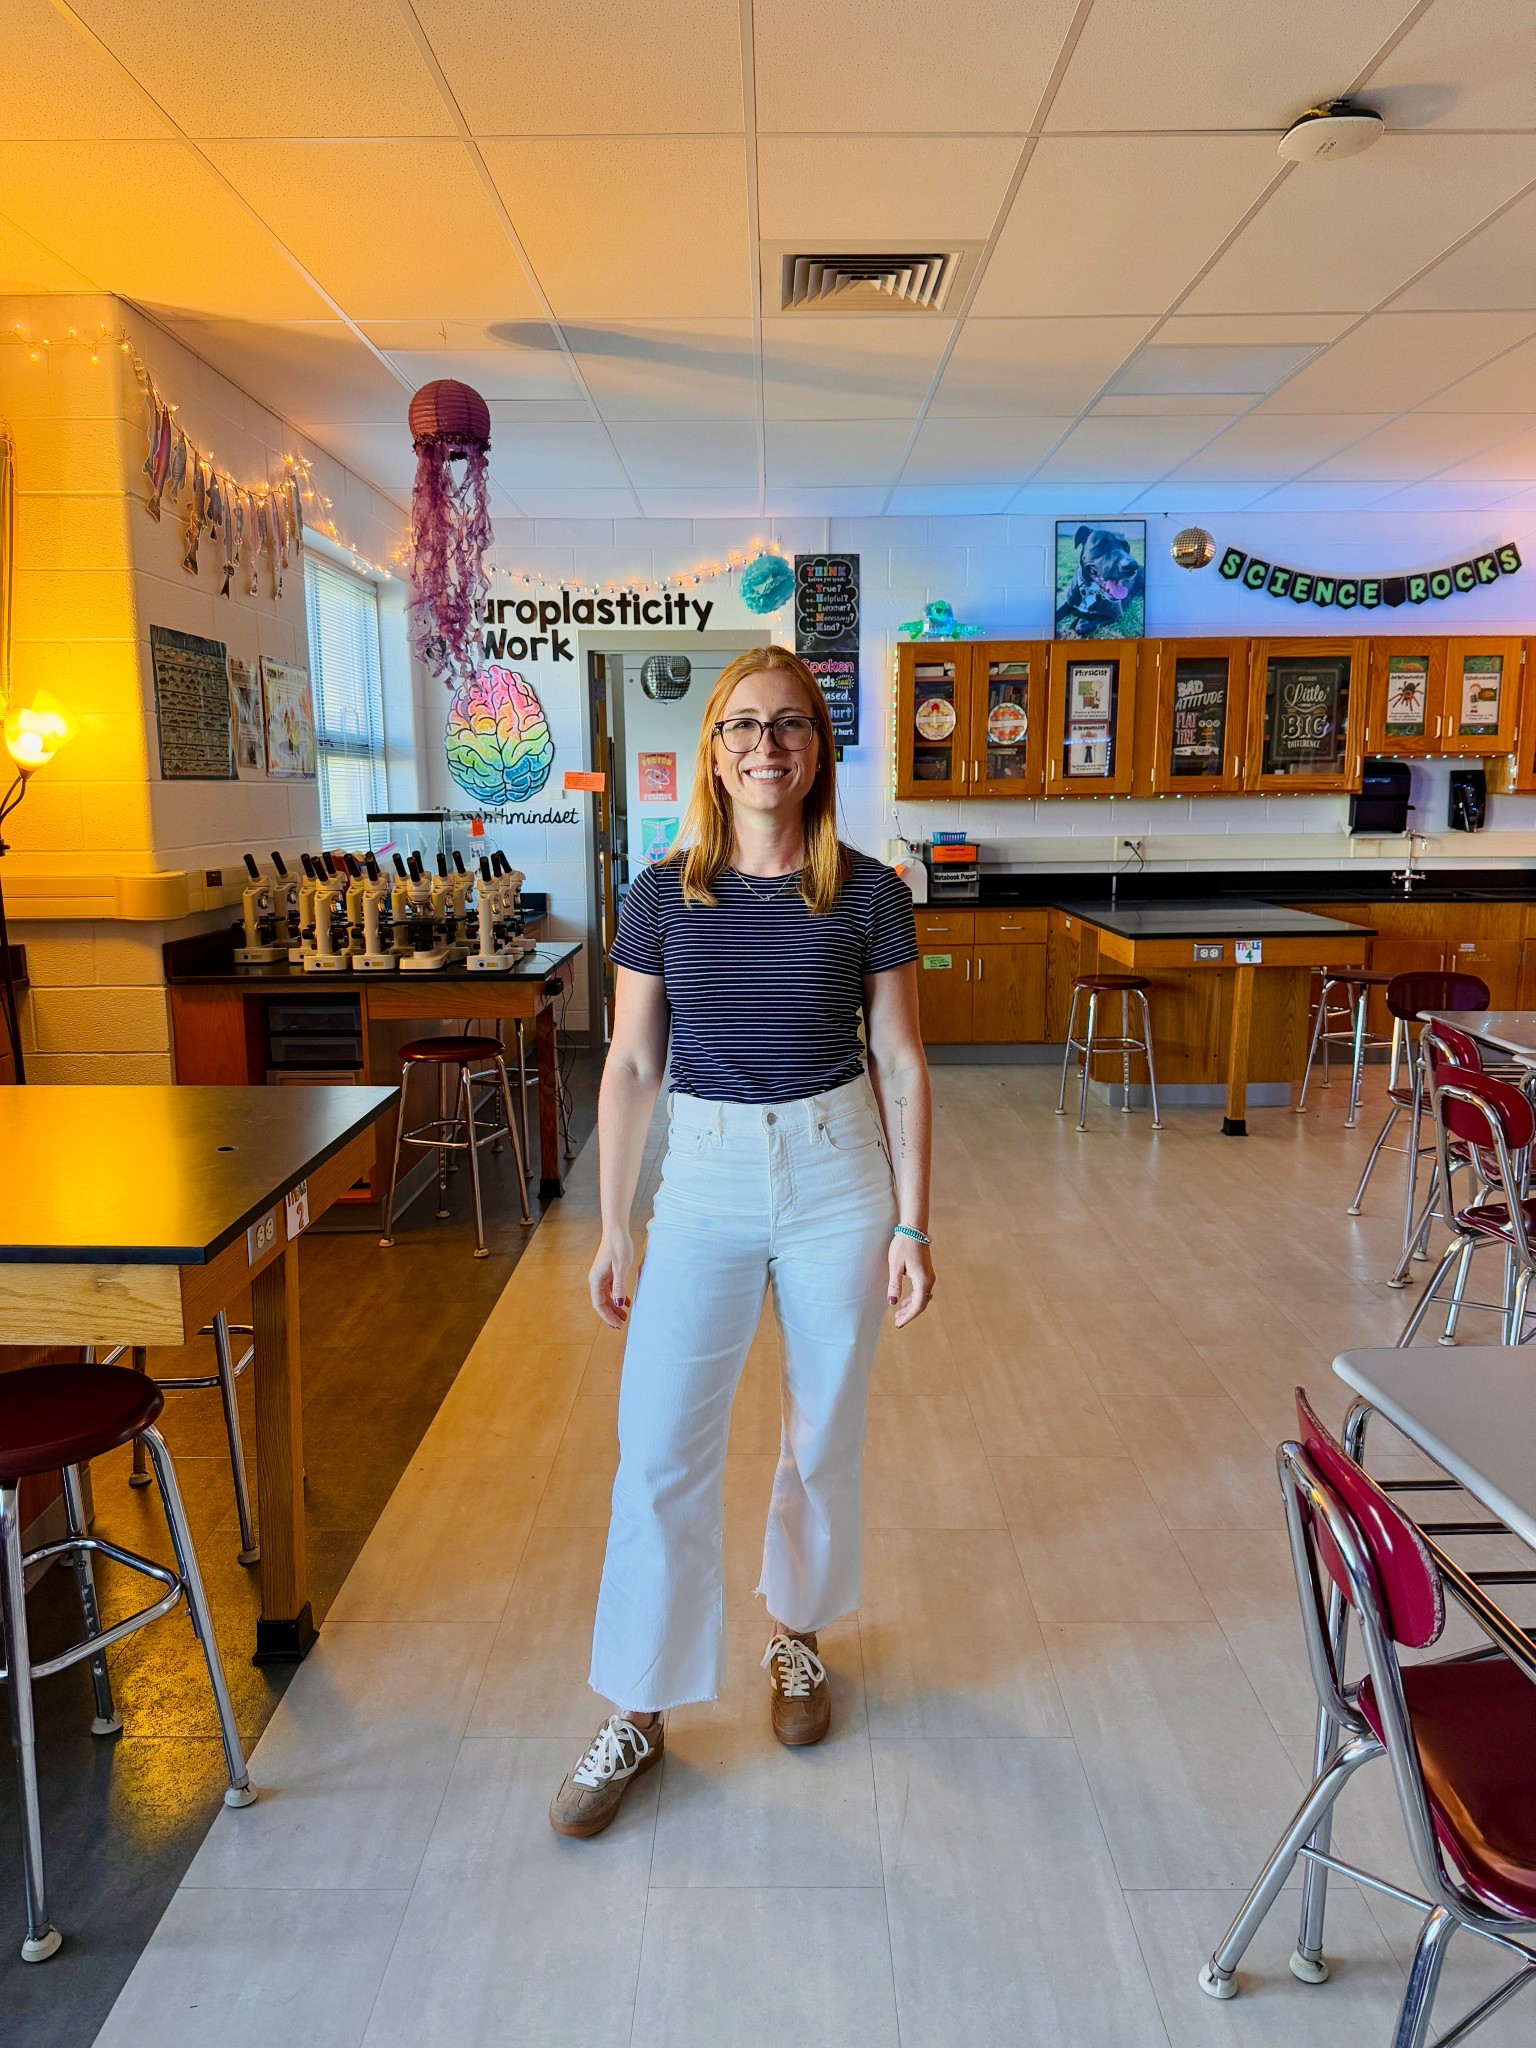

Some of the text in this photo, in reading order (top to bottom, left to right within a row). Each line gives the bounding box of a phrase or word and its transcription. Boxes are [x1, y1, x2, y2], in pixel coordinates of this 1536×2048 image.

[806, 565, 846, 577] THINK
[1222, 549, 1518, 605] SCIENCE ROCKS
[815, 584, 841, 593] True?
[815, 594, 848, 603] Helpful?
[474, 591, 713, 632] uroplasticity
[483, 628, 574, 662] Work
[801, 658, 855, 673] Spoken
[818, 675, 835, 687] rds
[1177, 680, 1204, 697] BAD
[1175, 690, 1224, 711] ATTITUDE
[1284, 683, 1327, 705] Little
[1176, 711, 1198, 728] FLAT
[1281, 714, 1329, 738] BIG
[1175, 728, 1197, 745] TIRE
[1287, 739, 1320, 748] DIFFERENCE
[934, 872, 976, 881] Notebook Paper
[1236, 941, 1261, 950] TABLE
[1245, 950, 1253, 961] 4
[296, 1201, 305, 1231] 2
